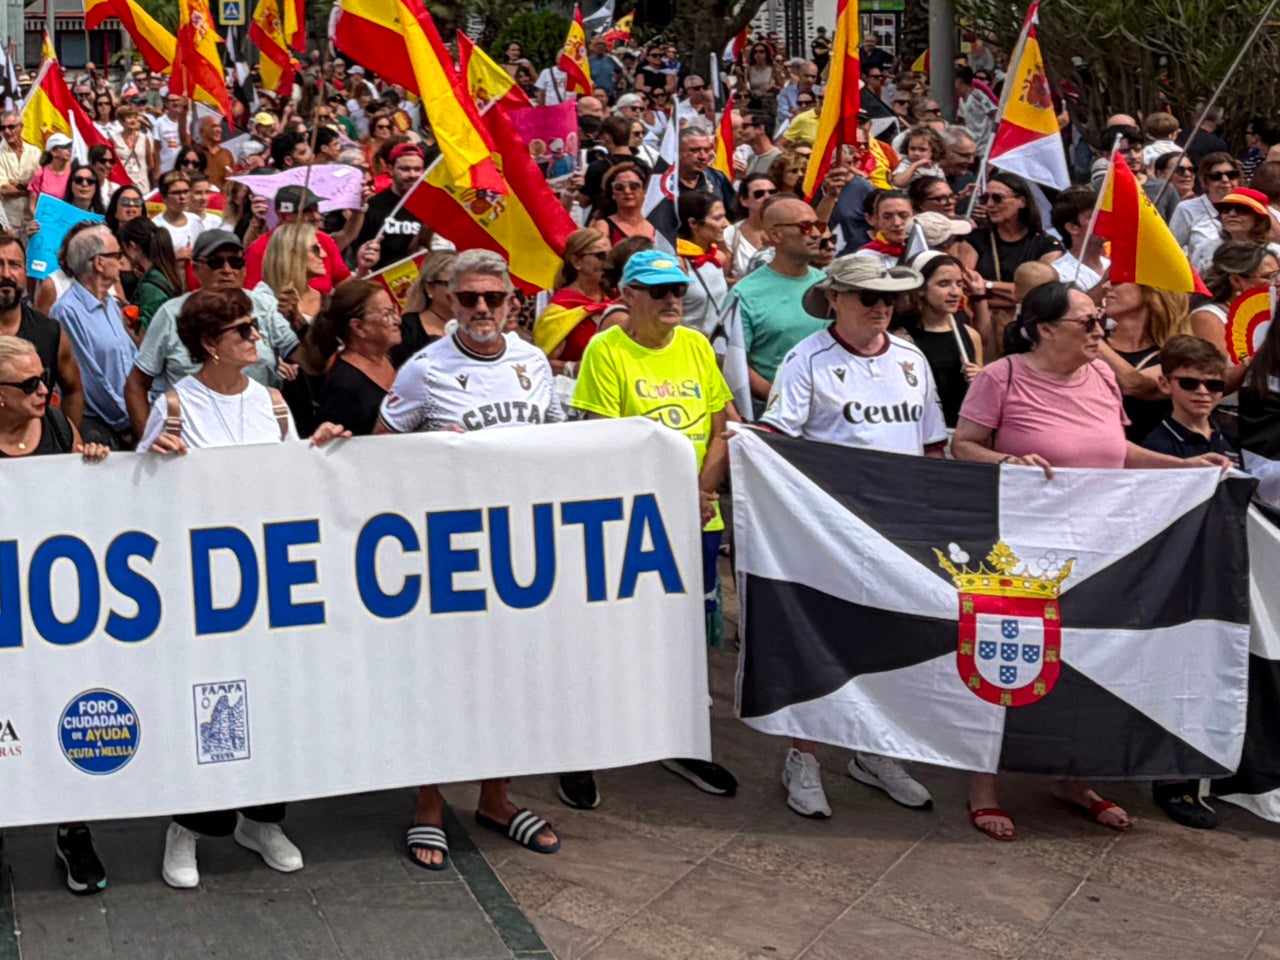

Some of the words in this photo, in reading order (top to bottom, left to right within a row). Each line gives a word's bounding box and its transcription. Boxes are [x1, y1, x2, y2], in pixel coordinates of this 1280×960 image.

[462, 400, 541, 432] CEUTA
[190, 520, 326, 637] DE
[355, 494, 684, 620] CEUTA
[78, 699, 119, 715] FORO
[63, 713, 135, 730] CIUDADANO
[71, 731, 83, 740] DE
[85, 727, 131, 742] AYUDA
[68, 747, 95, 759] CEUTA
[101, 745, 134, 758] MELILLA
[210, 752, 236, 762] CEUTA
